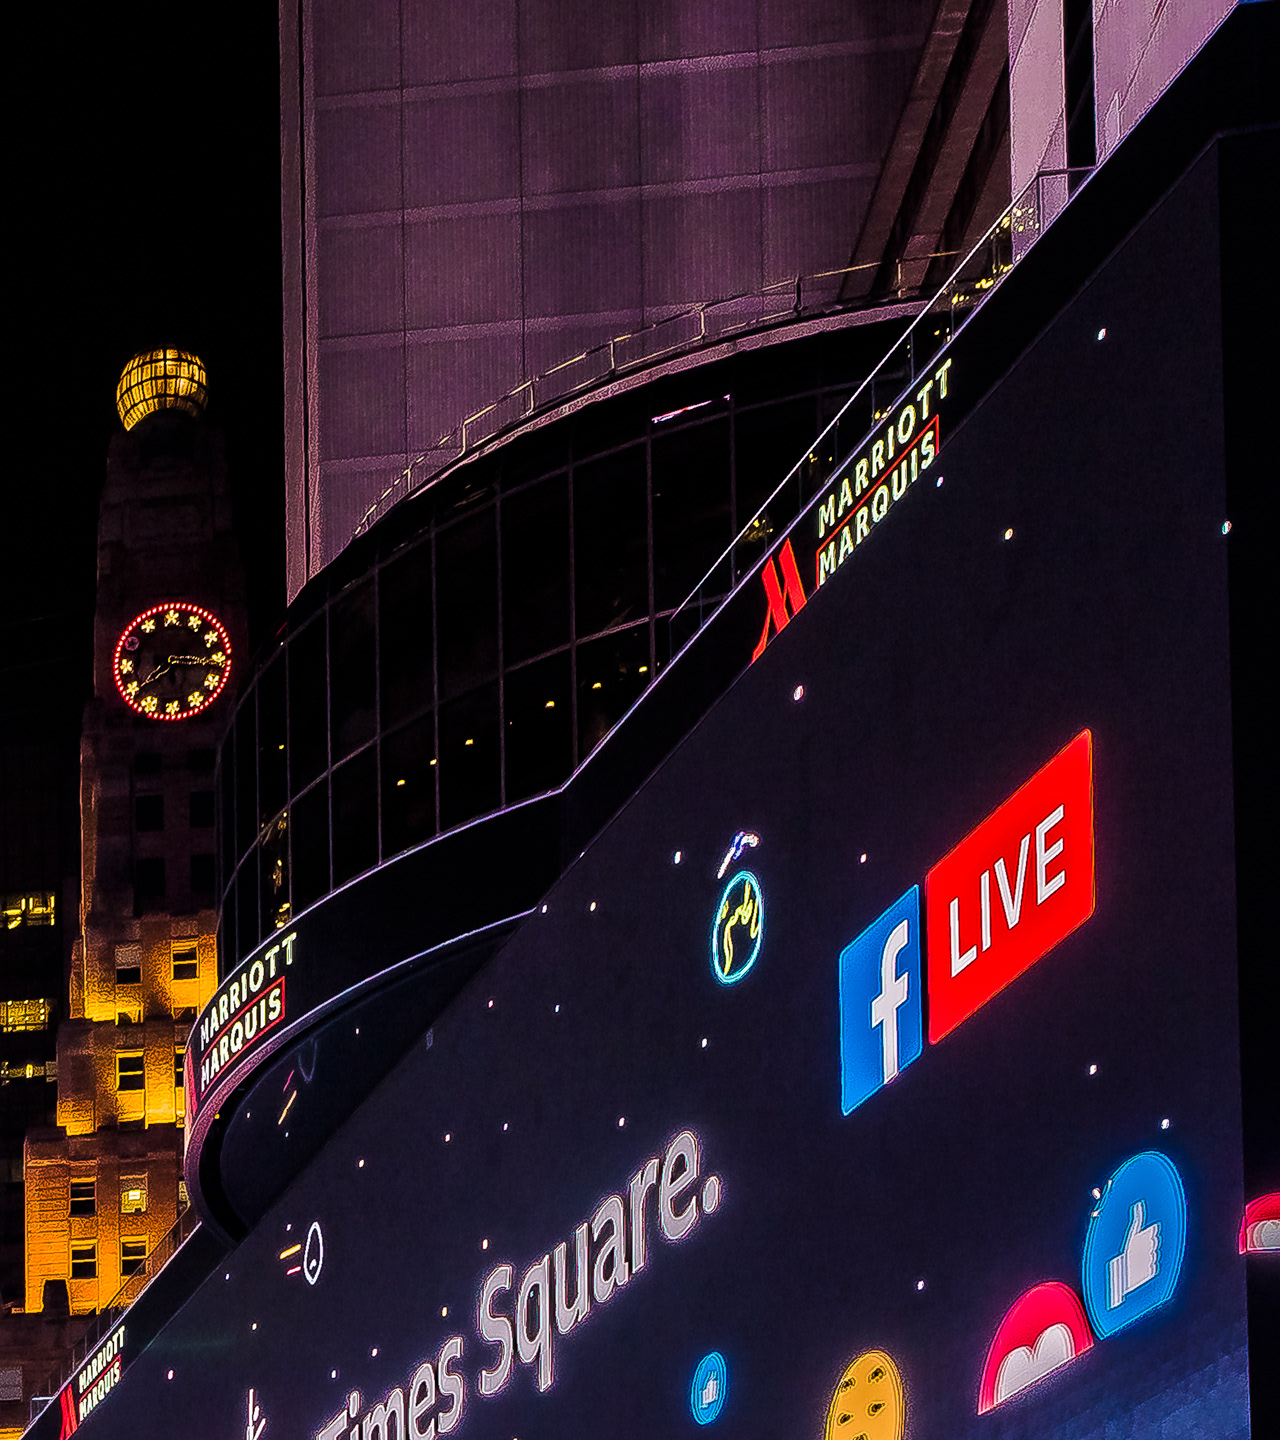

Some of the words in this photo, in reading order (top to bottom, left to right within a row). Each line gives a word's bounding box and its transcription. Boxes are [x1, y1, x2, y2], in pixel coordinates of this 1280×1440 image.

[817, 358, 952, 538] MARRIOTT
[818, 430, 936, 588] MARQUIS
[949, 803, 1065, 979] LIVE
[199, 932, 297, 1052] MARRIOTT
[199, 988, 283, 1093] MARQUIS
[478, 1130, 721, 1396] Square.
[78, 1325, 126, 1393] MARRIOTT
[78, 1360, 121, 1421] MARQUIS
